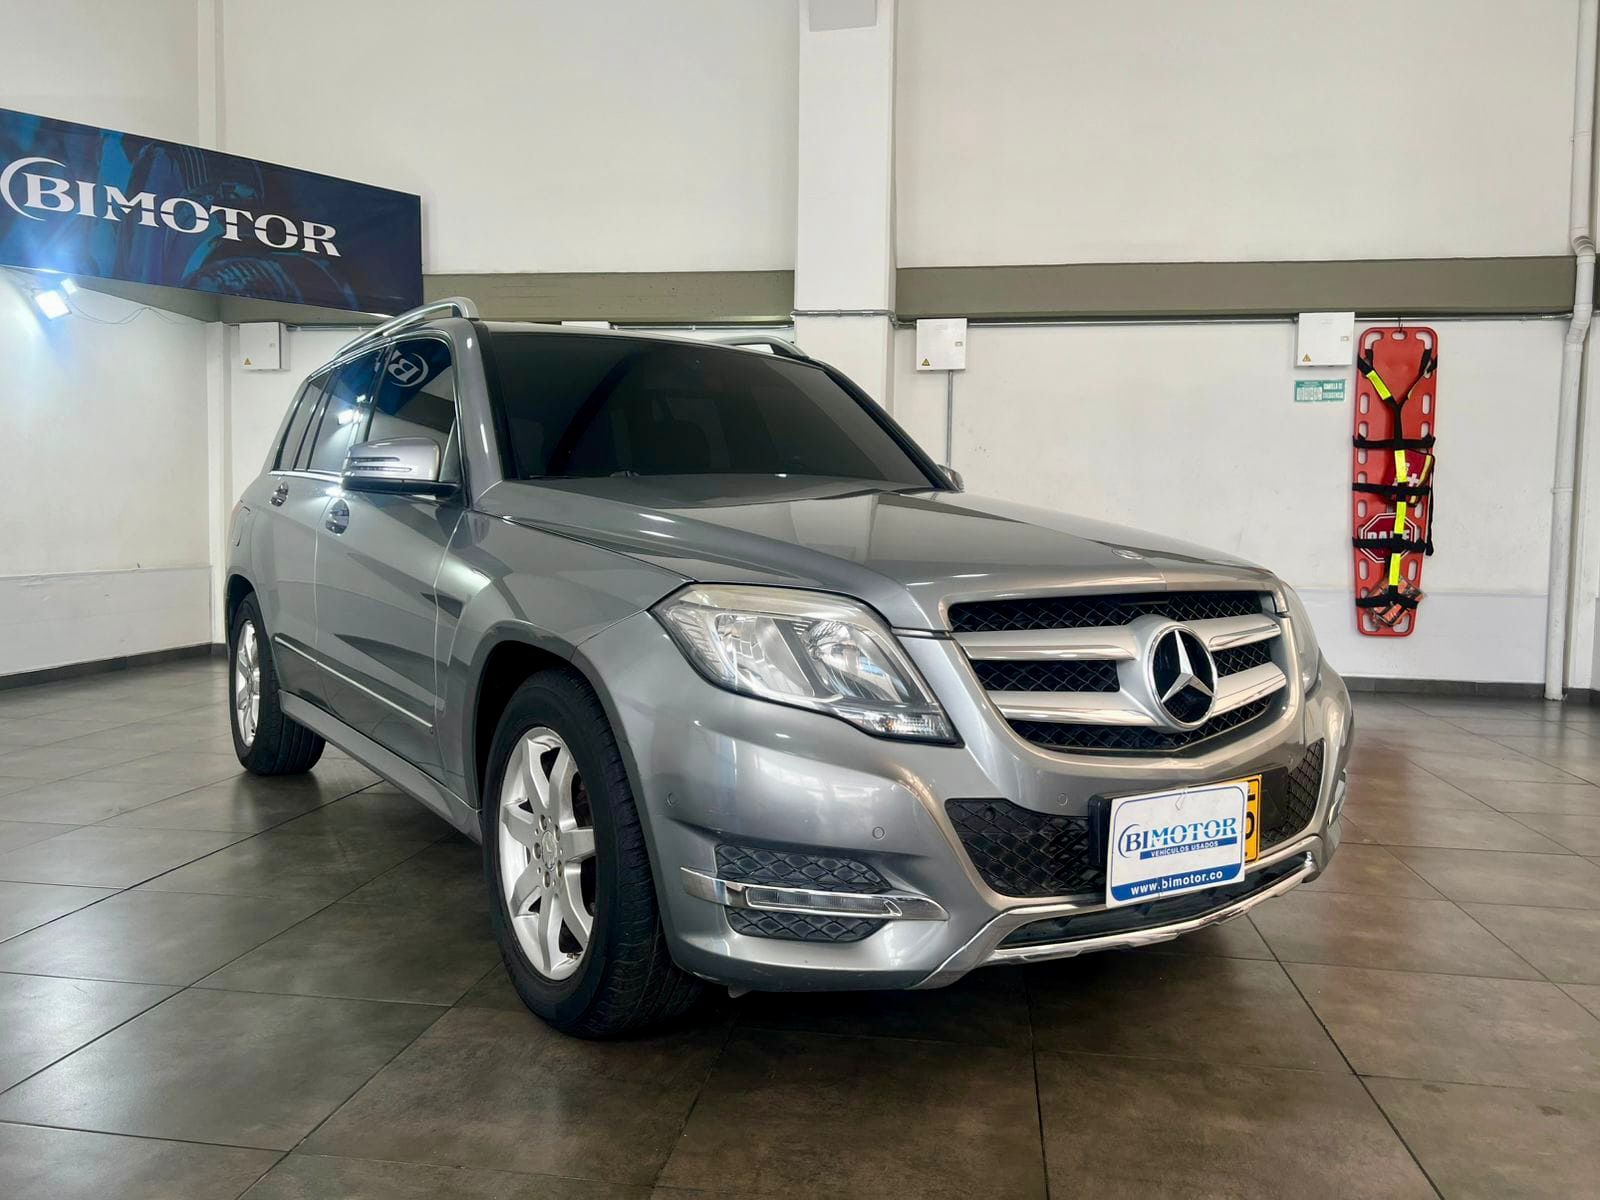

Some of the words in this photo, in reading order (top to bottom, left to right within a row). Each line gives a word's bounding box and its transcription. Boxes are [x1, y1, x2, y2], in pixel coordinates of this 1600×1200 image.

[23, 171, 342, 257] BIMOTOR
[1125, 817, 1237, 853] BIMOTOR
[1191, 841, 1219, 851] USADOS
[1131, 870, 1223, 896] www.bimotor.co
